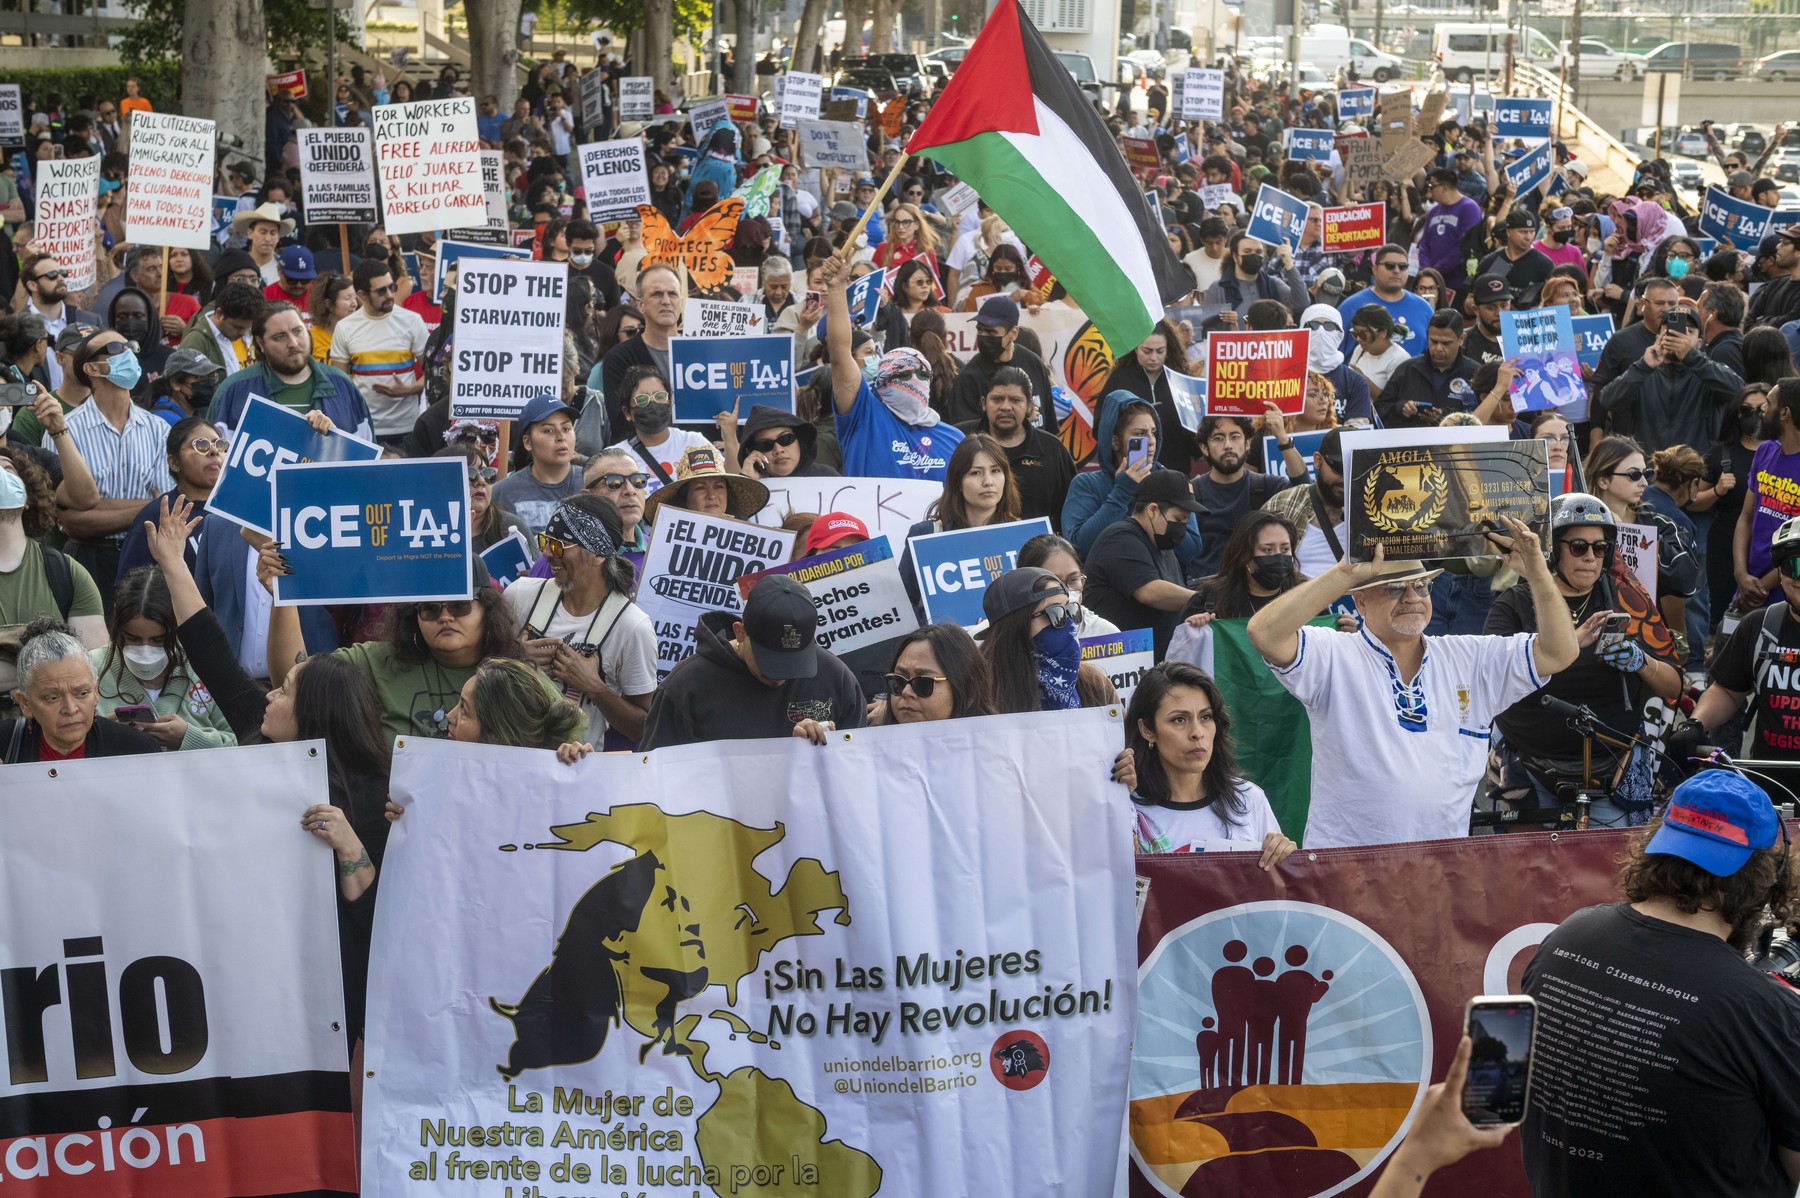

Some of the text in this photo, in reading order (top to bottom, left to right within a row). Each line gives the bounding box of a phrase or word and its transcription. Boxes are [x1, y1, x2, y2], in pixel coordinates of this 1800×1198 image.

[787, 76, 821, 88] STOP THE
[1187, 72, 1205, 80] STOP
[375, 100, 470, 122] FOR WORKERS
[784, 104, 817, 115] STOP THE
[1208, 98, 1220, 106] THE
[1341, 97, 1358, 108] ICE
[133, 114, 215, 134] FULL CITIZENSHIP
[1495, 109, 1519, 123] ICE
[305, 133, 364, 146] ¡EL PUEBLO
[376, 121, 454, 140] ACTION TO
[132, 130, 210, 151] RIGHTS FOR ALL
[1292, 138, 1312, 149] ICE
[130, 148, 204, 168] IMMIGRANTS!
[311, 145, 361, 161] UNIDO
[381, 141, 480, 160] FREE ALFREDO
[584, 146, 639, 164] ¡DERECHOS
[130, 163, 212, 185] ¡PLENOS DERECHOS
[309, 160, 365, 172] DEFENDERÁ
[422, 161, 478, 177] JUAREZ
[586, 158, 641, 178] PLENOS
[41, 180, 89, 199] ACTION
[130, 182, 200, 199] DE CIUDADANIA
[308, 184, 370, 192] A LAS FAMILIAS
[386, 179, 463, 200] & KILMAR
[590, 186, 645, 199] PARA TODOS LOS
[309, 193, 371, 203] MIGRANTES!
[387, 193, 484, 216] ABREGO GARCIA
[40, 199, 89, 220] SMASH
[129, 199, 205, 218] PARA TODOS LOS
[1256, 201, 1283, 226] ICE
[1326, 208, 1371, 223] EDUCACIÓN
[1705, 200, 1728, 226] ICE
[128, 215, 203, 232] INMIGRANTES!
[1326, 223, 1338, 233] NO
[1326, 227, 1380, 243] DEPORTACIÓN
[654, 238, 712, 254] PROTECT
[463, 272, 563, 299] STOP THE
[461, 307, 561, 328] STARVATION!
[702, 310, 748, 324] COME FOR
[1515, 315, 1556, 328] COME FOR
[721, 321, 732, 332] of
[1533, 326, 1543, 335] of
[1517, 333, 1559, 346] COME FOR
[1520, 340, 1557, 353] all us!
[1216, 340, 1293, 360] EDUCATION
[458, 350, 559, 375] STOP THE
[1216, 361, 1248, 379] NOT
[675, 360, 789, 390] ICE OUT OF LA!
[457, 383, 556, 398] DEPORATIONS!
[1215, 378, 1301, 399] DEPORTATION
[230, 432, 299, 482] ICE
[1378, 450, 1434, 464] AMGLA
[1481, 482, 1499, 493] (323)
[1772, 511, 1789, 520] LOCAL
[280, 500, 461, 550] ICE OUT OF LA!
[666, 520, 783, 560] ¡EL PUEBLO
[1403, 534, 1448, 544] DE MIGRANTES
[1622, 534, 1638, 547] FOR
[845, 553, 865, 569] POR
[921, 554, 1003, 596] ICE OUT
[829, 605, 858, 623] los
[1108, 642, 1124, 654] FOR
[764, 949, 1041, 1000] ¡Sin Las Mujeres
[1553, 947, 1699, 1003] American Cinematheque
[767, 979, 1112, 1043] No Hay Revolución!
[1660, 1014, 1680, 1024] (1977)
[824, 1050, 983, 1074] uniondelbarrio.org
[834, 1073, 978, 1094] @UniondelBarrio
[507, 1084, 695, 1125] La Mujer de
[0, 1107, 207, 1182] ación
[420, 1119, 685, 1152] Nuestra América
[1569, 1146, 1604, 1162] 2022
[408, 1151, 820, 1192] al frente de la lucha por la
